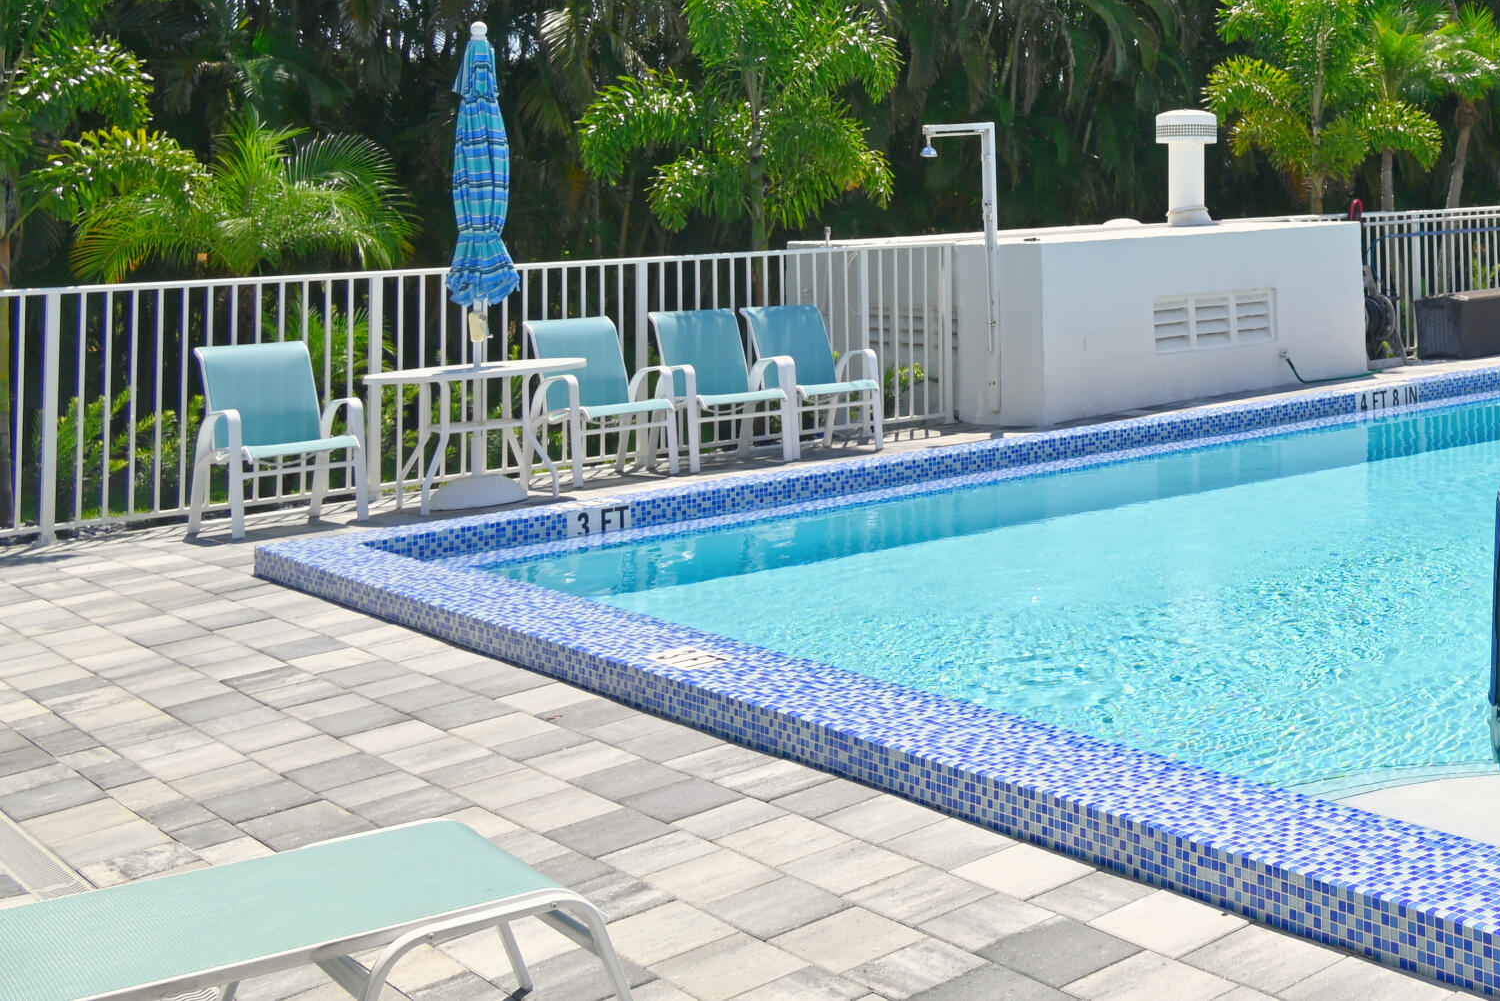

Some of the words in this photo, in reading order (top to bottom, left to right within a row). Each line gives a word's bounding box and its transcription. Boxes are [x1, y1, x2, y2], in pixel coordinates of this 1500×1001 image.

[1360, 393, 1368, 410] 4
[1372, 390, 1387, 409] FT
[1392, 389, 1399, 407] 8
[1405, 386, 1418, 405] IN
[577, 512, 590, 536] 3
[601, 505, 629, 534] FT
[656, 649, 697, 660] 3
[671, 654, 727, 668] FT
